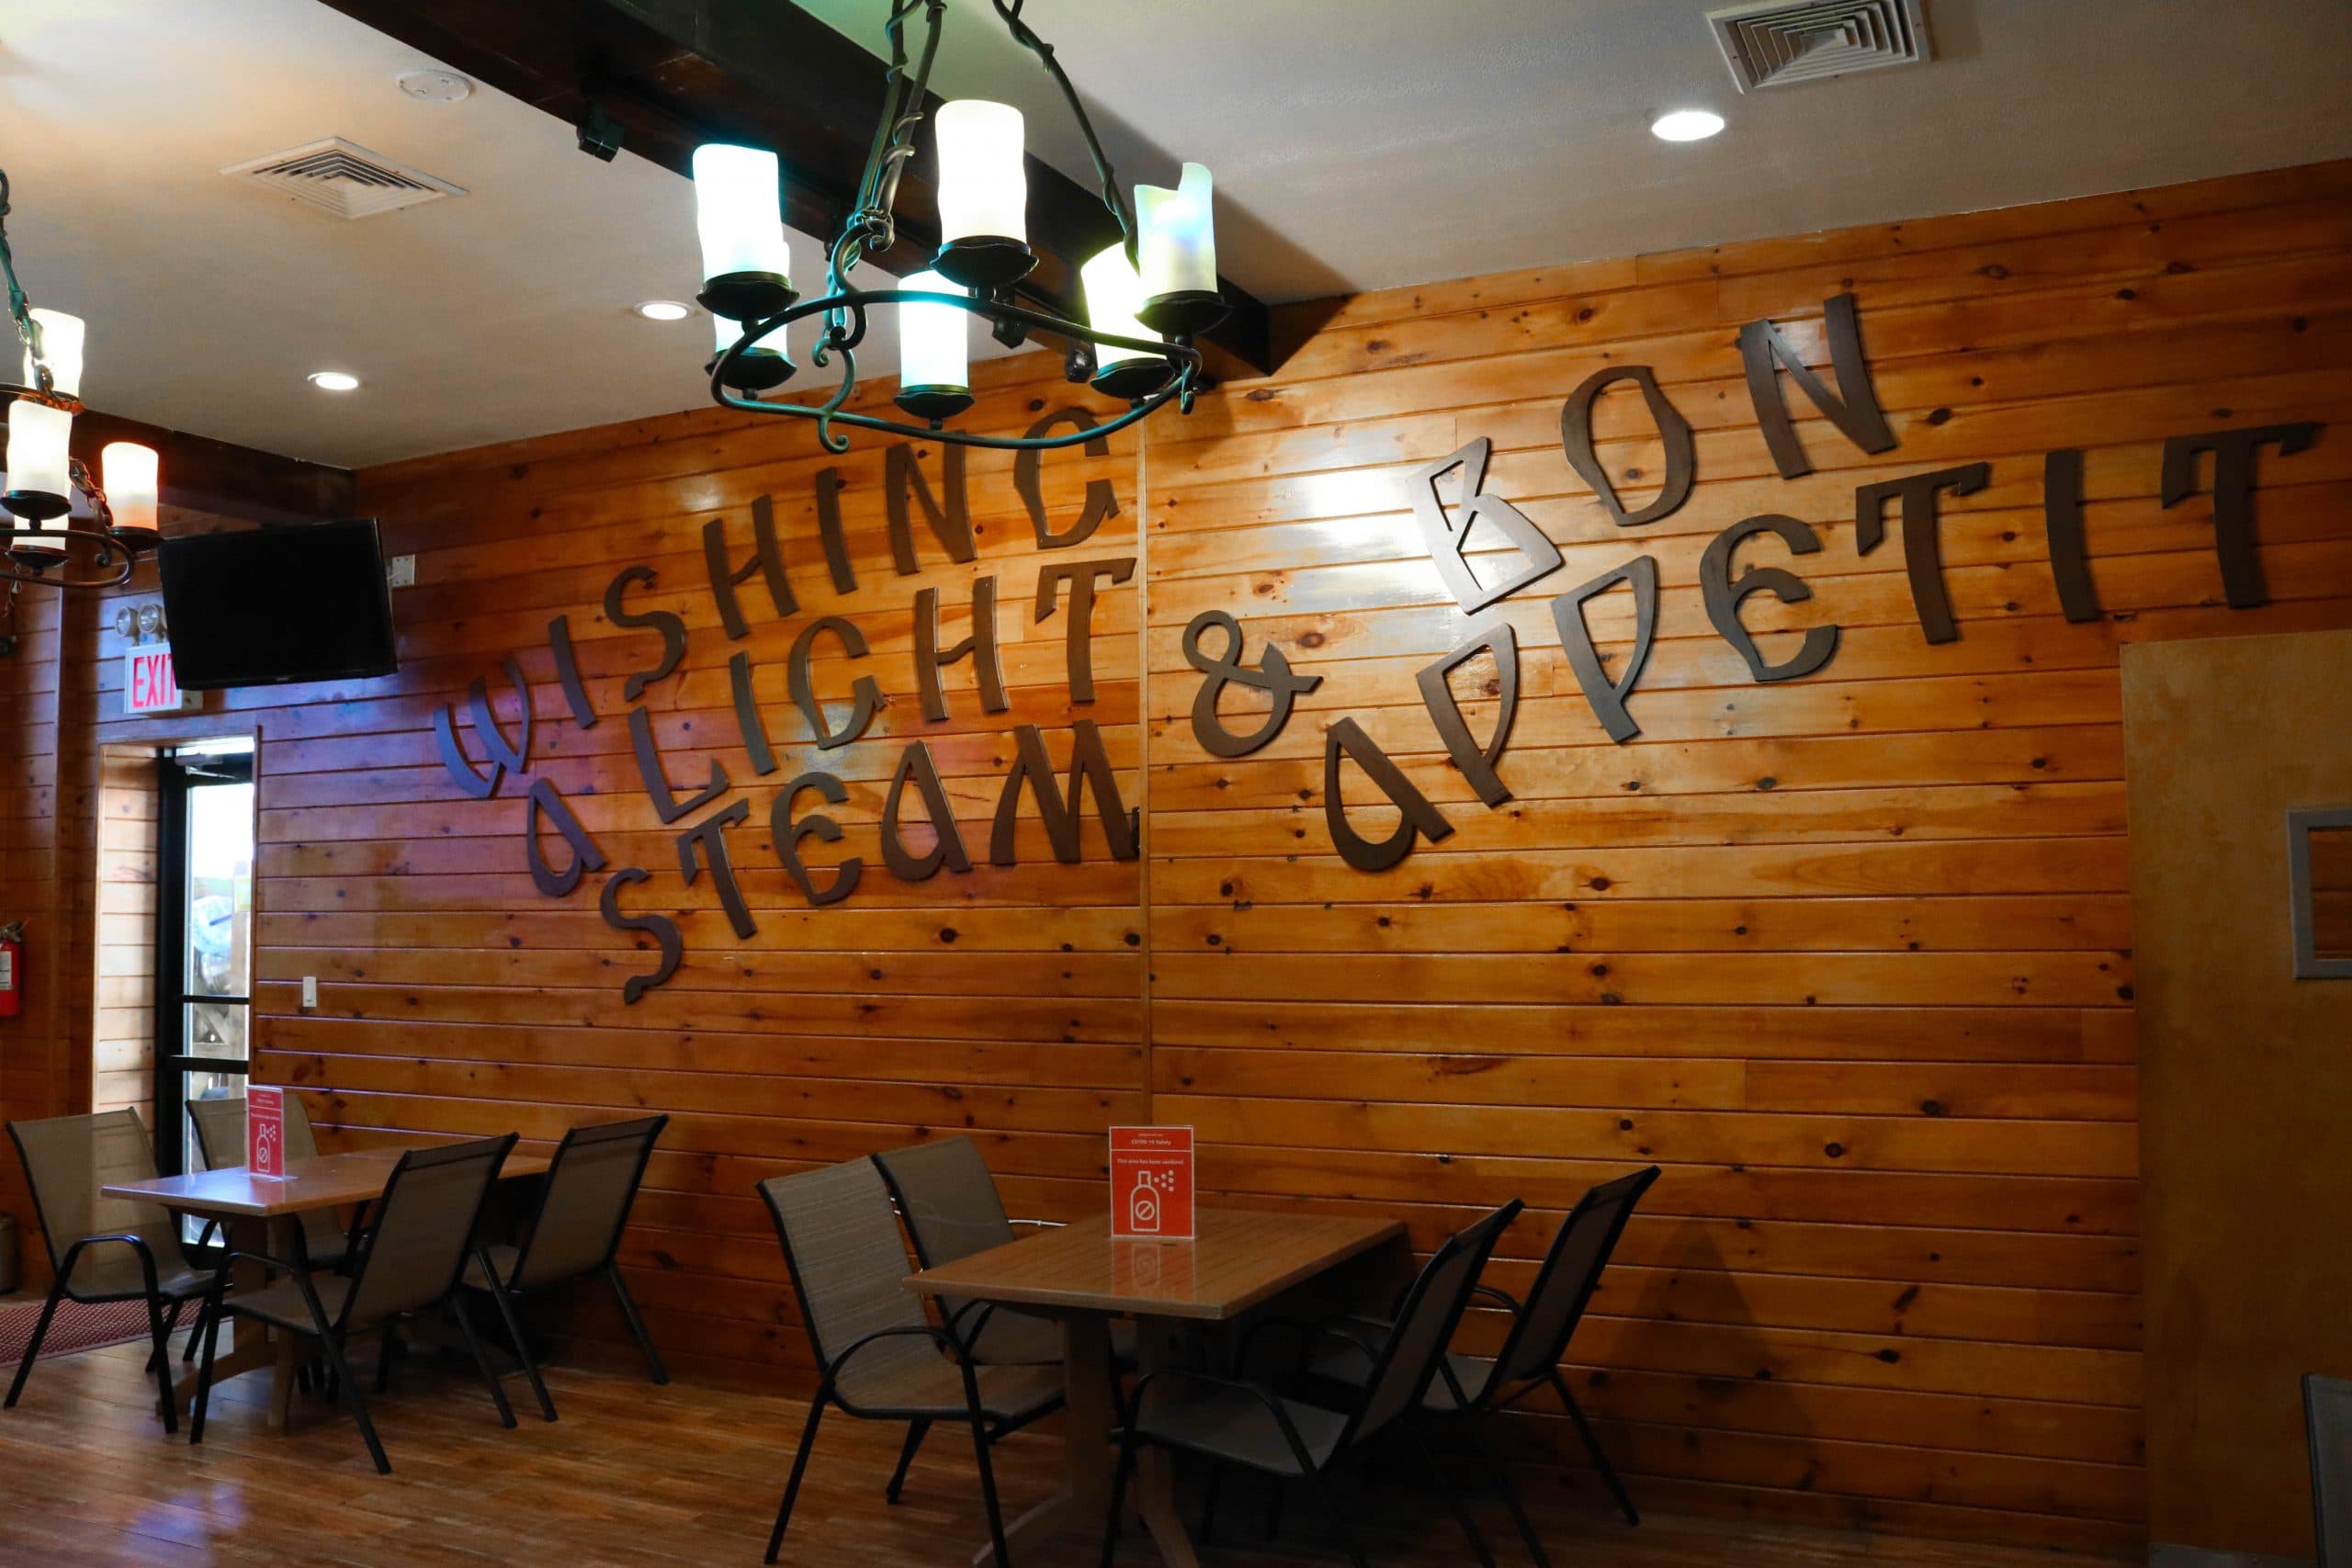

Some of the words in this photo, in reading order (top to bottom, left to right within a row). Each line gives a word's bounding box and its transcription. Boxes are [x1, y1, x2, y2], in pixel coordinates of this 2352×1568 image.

[434, 407, 1121, 800] WISHING
[1406, 292, 1897, 615] BON
[132, 653, 175, 709] EXIT
[526, 778, 607, 898] A
[628, 557, 1138, 825] LIGHT
[1181, 609, 1324, 758] &
[1323, 421, 2324, 874] APPETIT
[599, 719, 1139, 1006] STEAM
